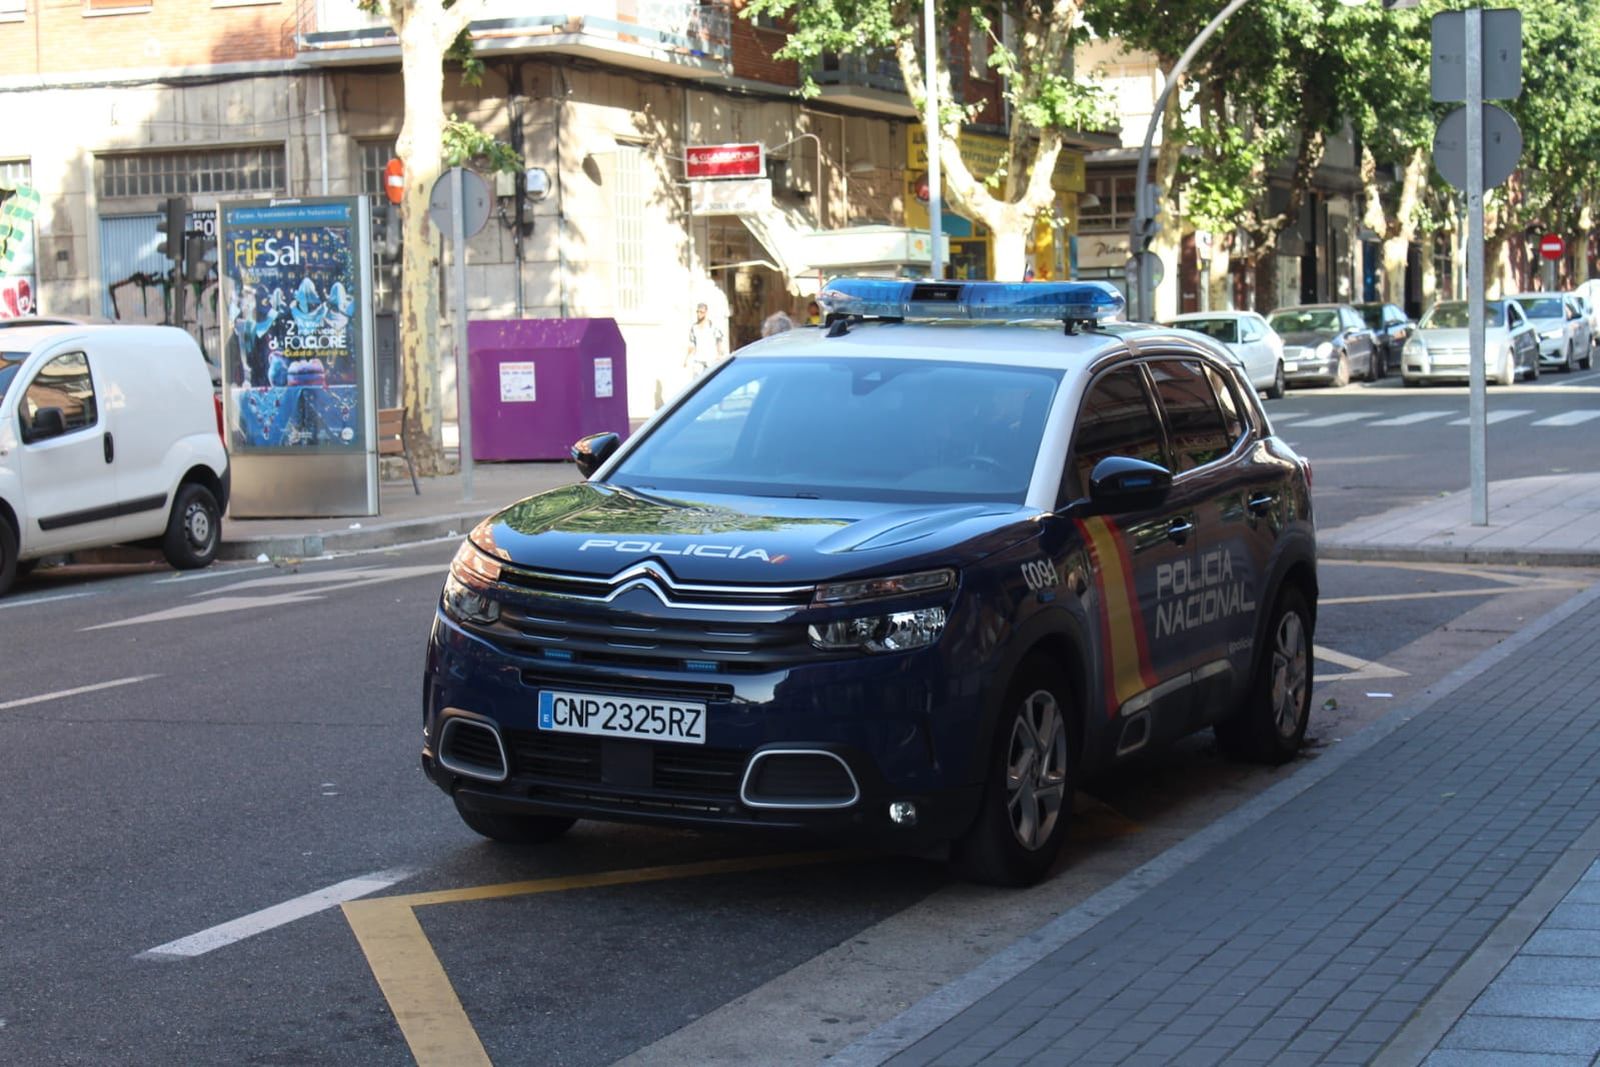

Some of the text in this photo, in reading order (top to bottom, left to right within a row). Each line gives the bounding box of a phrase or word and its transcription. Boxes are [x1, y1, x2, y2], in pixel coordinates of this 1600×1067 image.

[234, 235, 300, 267] FiFSal
[284, 335, 347, 350] FOLCLORE
[579, 539, 770, 562] POLICÍA
[1156, 543, 1233, 600] POLICÍA
[1155, 580, 1256, 639] NACIONAL
